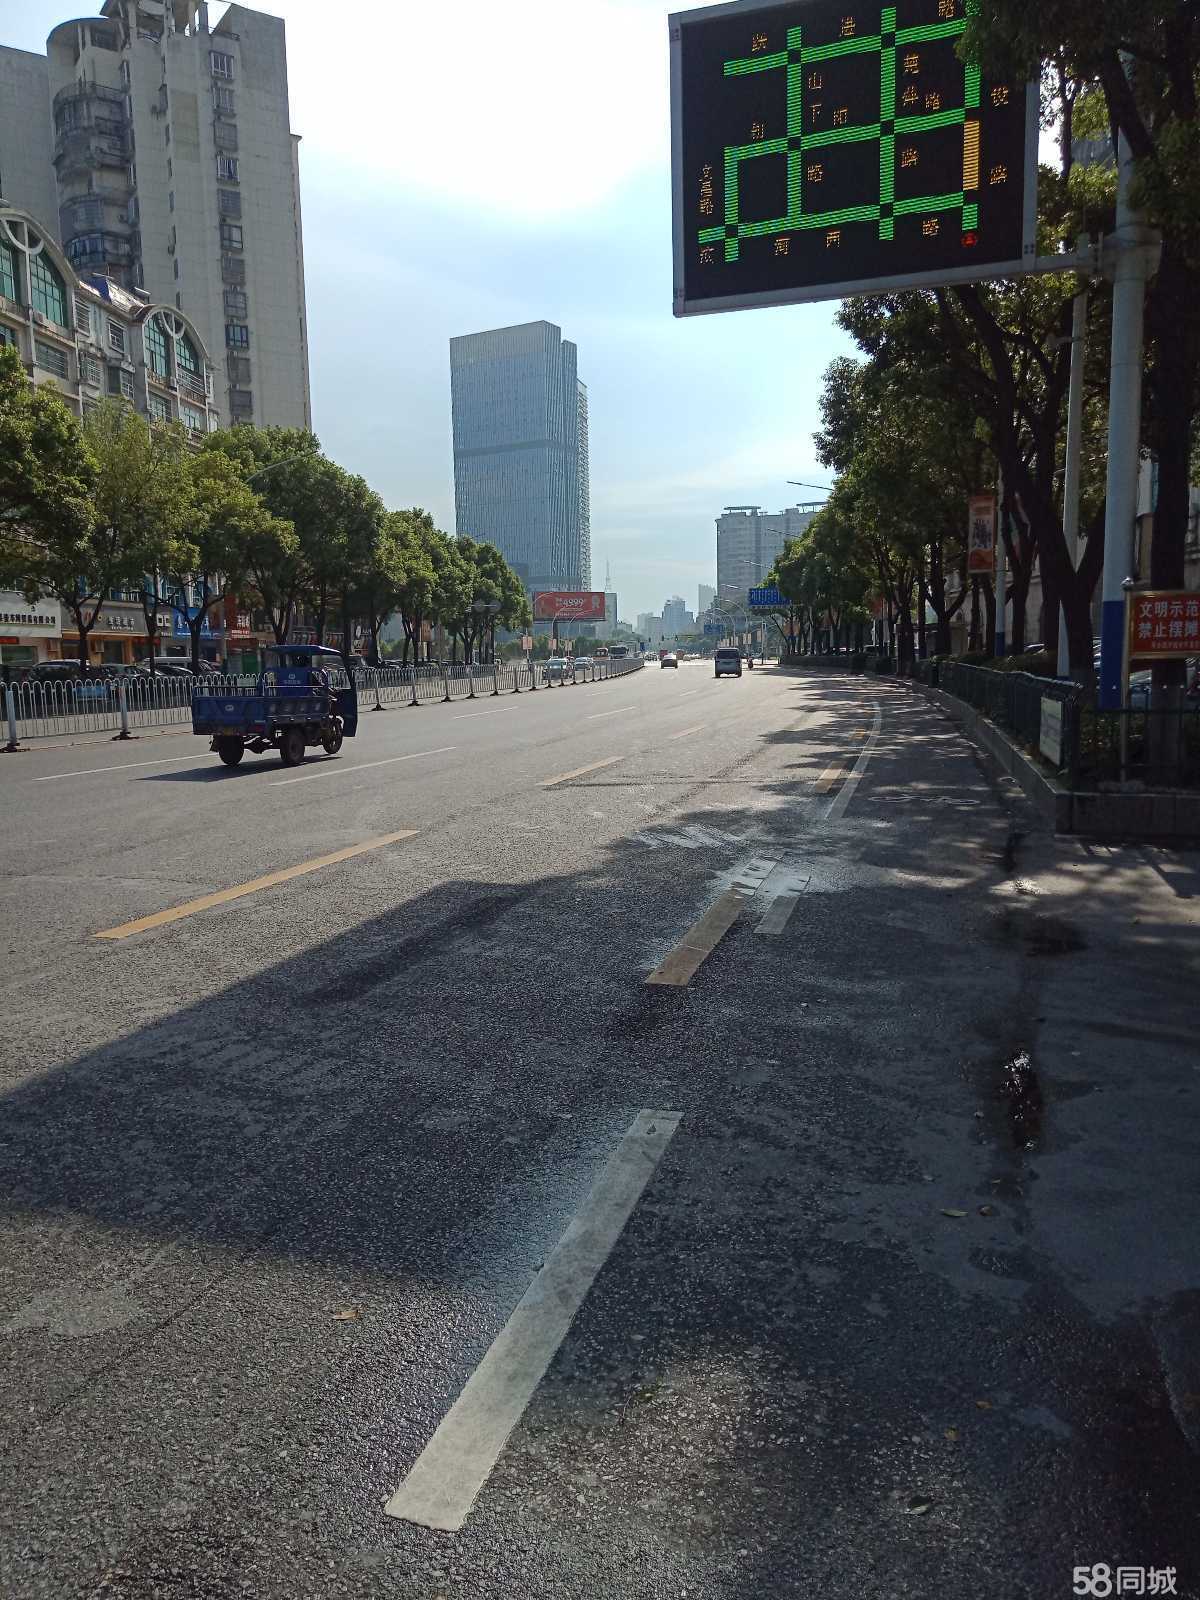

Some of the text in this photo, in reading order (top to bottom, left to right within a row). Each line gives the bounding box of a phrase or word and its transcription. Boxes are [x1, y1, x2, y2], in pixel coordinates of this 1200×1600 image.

[808, 72, 823, 90] 山
[810, 104, 823, 123] 下
[1139, 600, 1199, 618] 文明示范
[1138, 620, 1199, 639] 禁止摆摊
